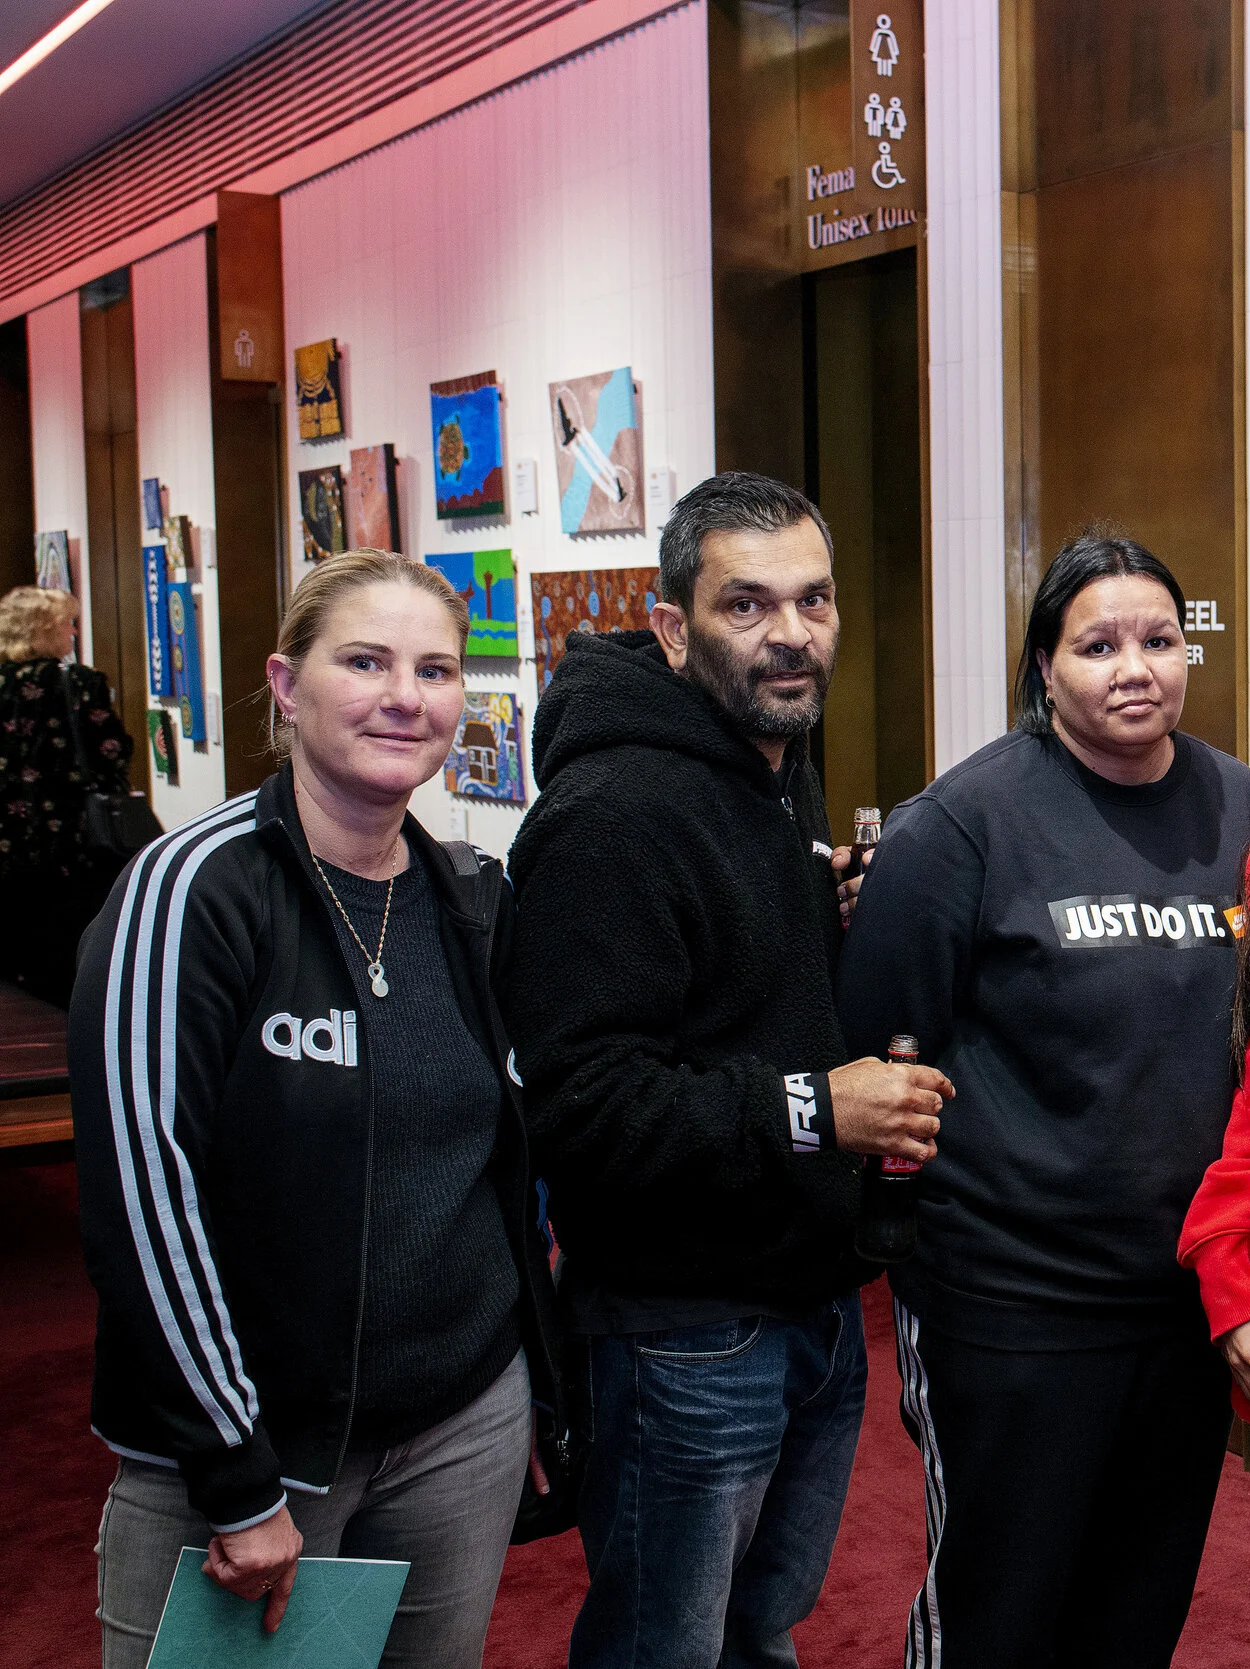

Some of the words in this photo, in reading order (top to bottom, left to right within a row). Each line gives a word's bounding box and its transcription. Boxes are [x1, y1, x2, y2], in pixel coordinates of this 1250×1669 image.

[808, 209, 871, 249] Unisex
[1065, 903, 1138, 941] JUST
[1140, 903, 1186, 940] DO
[1187, 904, 1226, 938] IT.
[261, 1008, 358, 1067] adi
